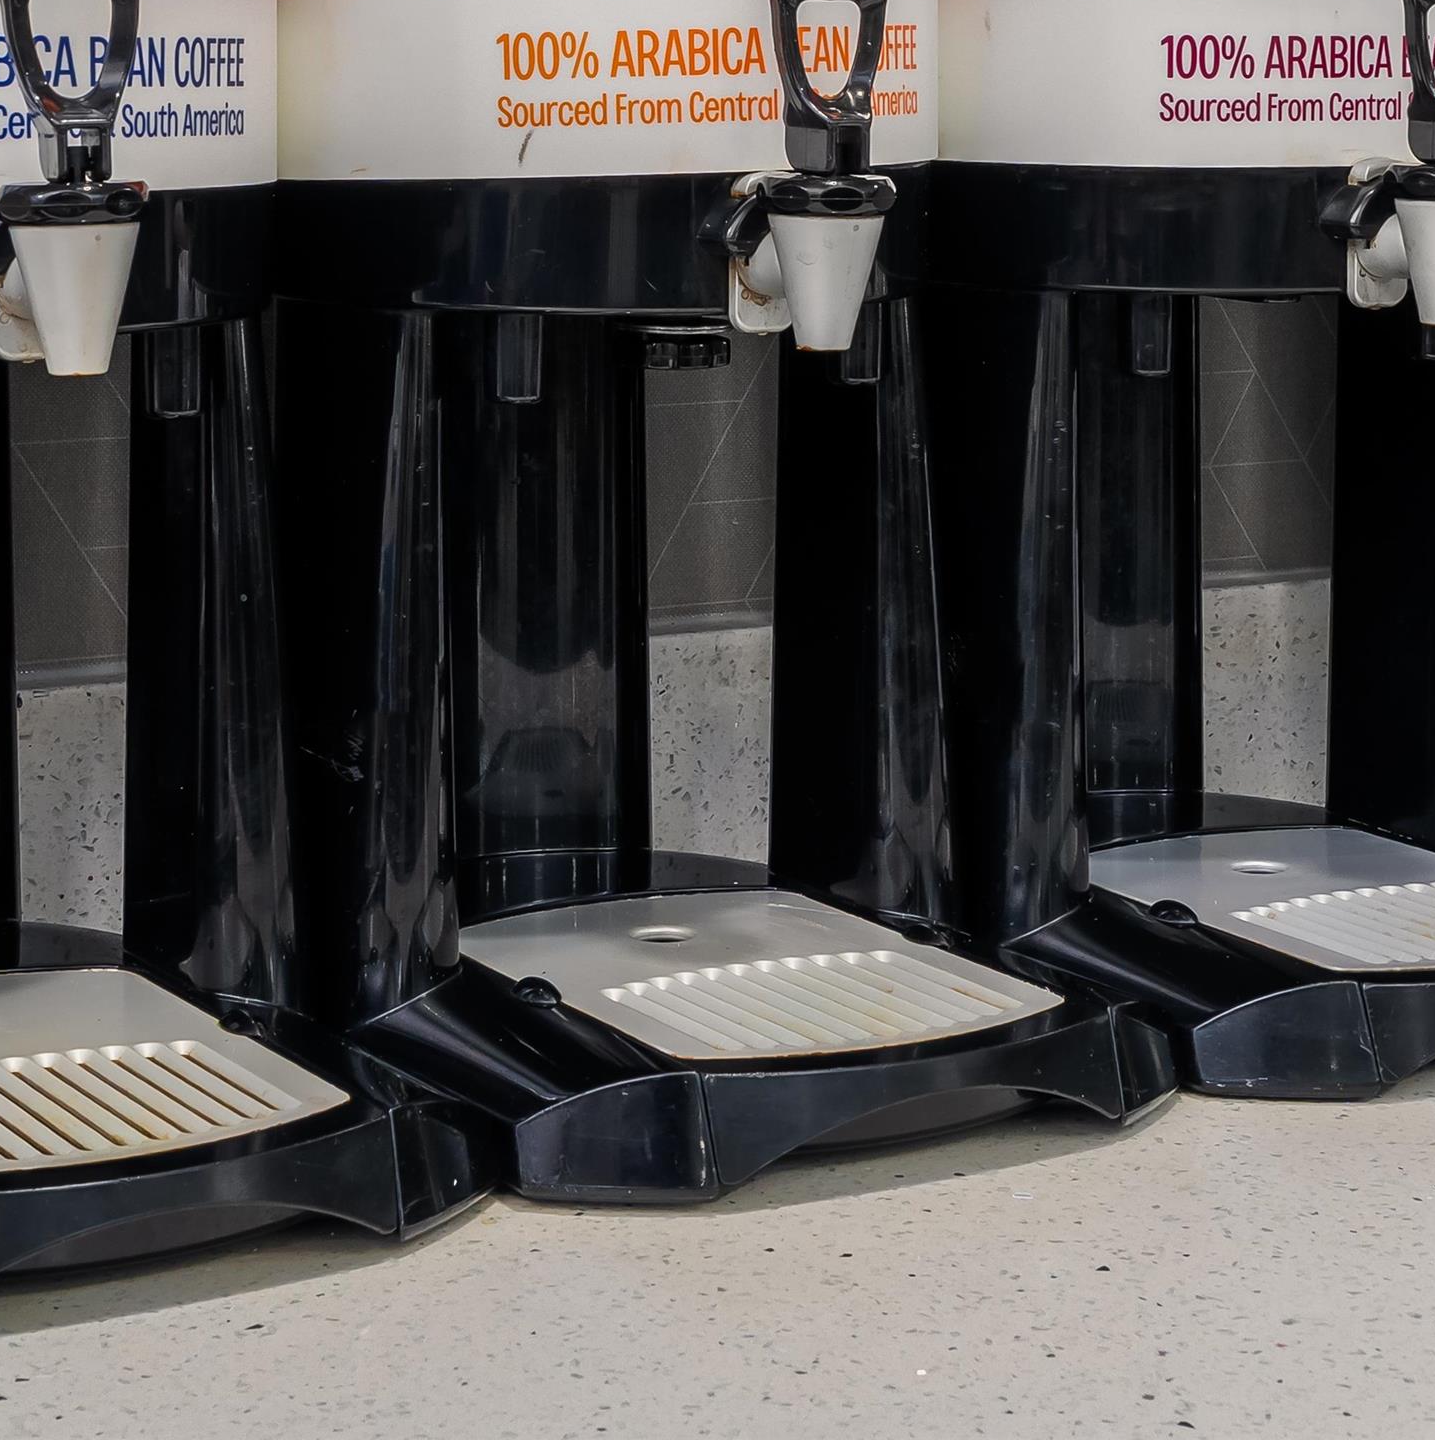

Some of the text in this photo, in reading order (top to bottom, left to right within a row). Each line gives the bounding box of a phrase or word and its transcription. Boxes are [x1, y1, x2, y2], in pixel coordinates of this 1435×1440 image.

[90, 36, 165, 87] BAN
[174, 37, 245, 88] COFFEE
[496, 30, 599, 81] 100%
[610, 26, 767, 78] ARABICA
[796, 26, 850, 72] EAN
[1160, 35, 1255, 79] 100%
[1264, 35, 1393, 79] ARABICA
[121, 101, 245, 138] South America
[497, 93, 607, 128] Sourced
[616, 93, 682, 125] From
[689, 89, 778, 123] Central
[1159, 92, 1260, 122] Sourced
[1267, 93, 1323, 121] From
[1330, 91, 1401, 121] Central
